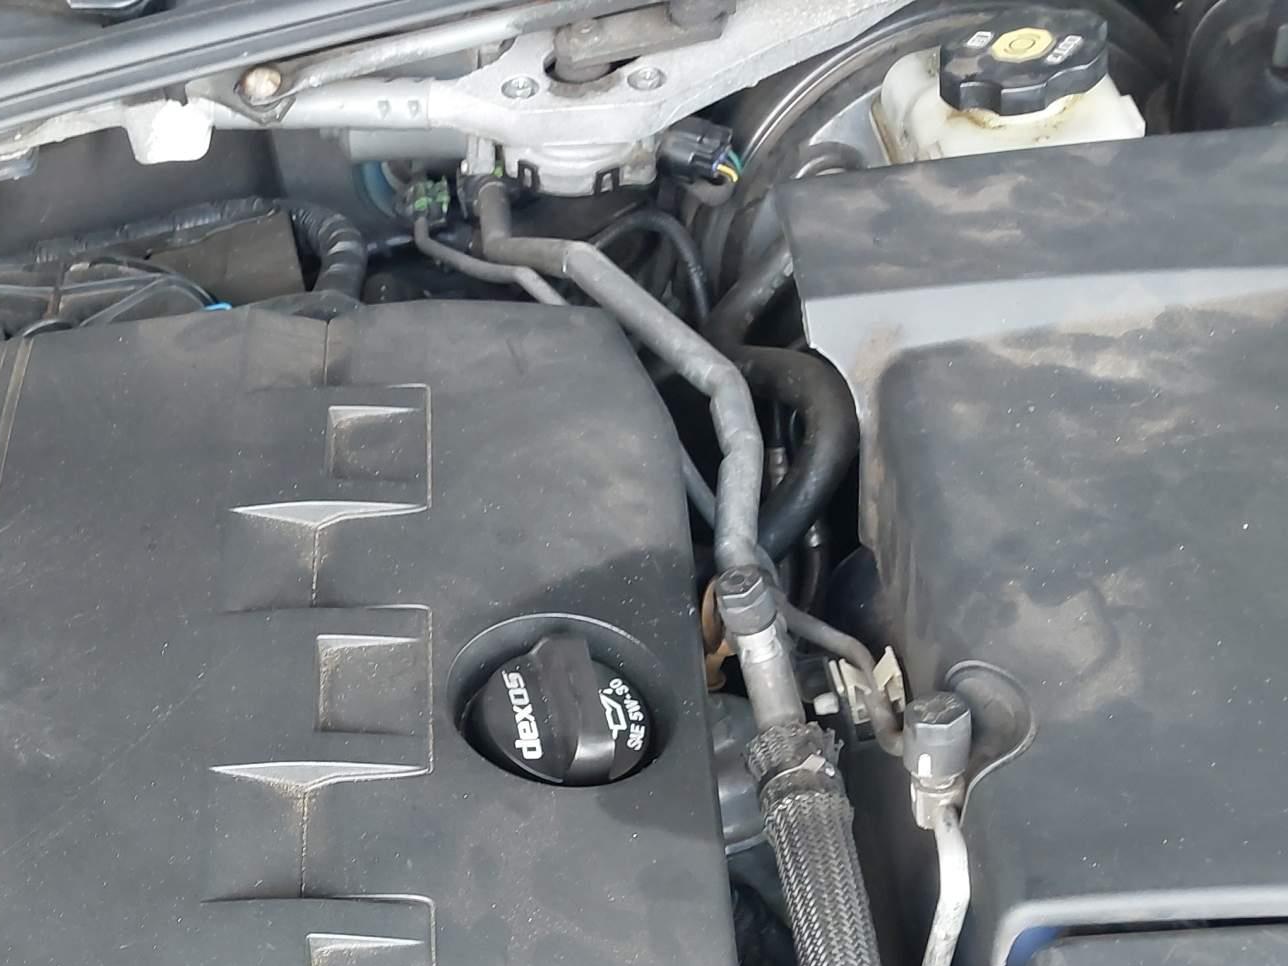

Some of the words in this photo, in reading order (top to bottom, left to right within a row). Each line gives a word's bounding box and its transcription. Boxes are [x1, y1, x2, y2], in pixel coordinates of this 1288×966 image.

[501, 670, 543, 760] dexos
[609, 678, 644, 721] 5W-30
[626, 723, 646, 751] SAE
